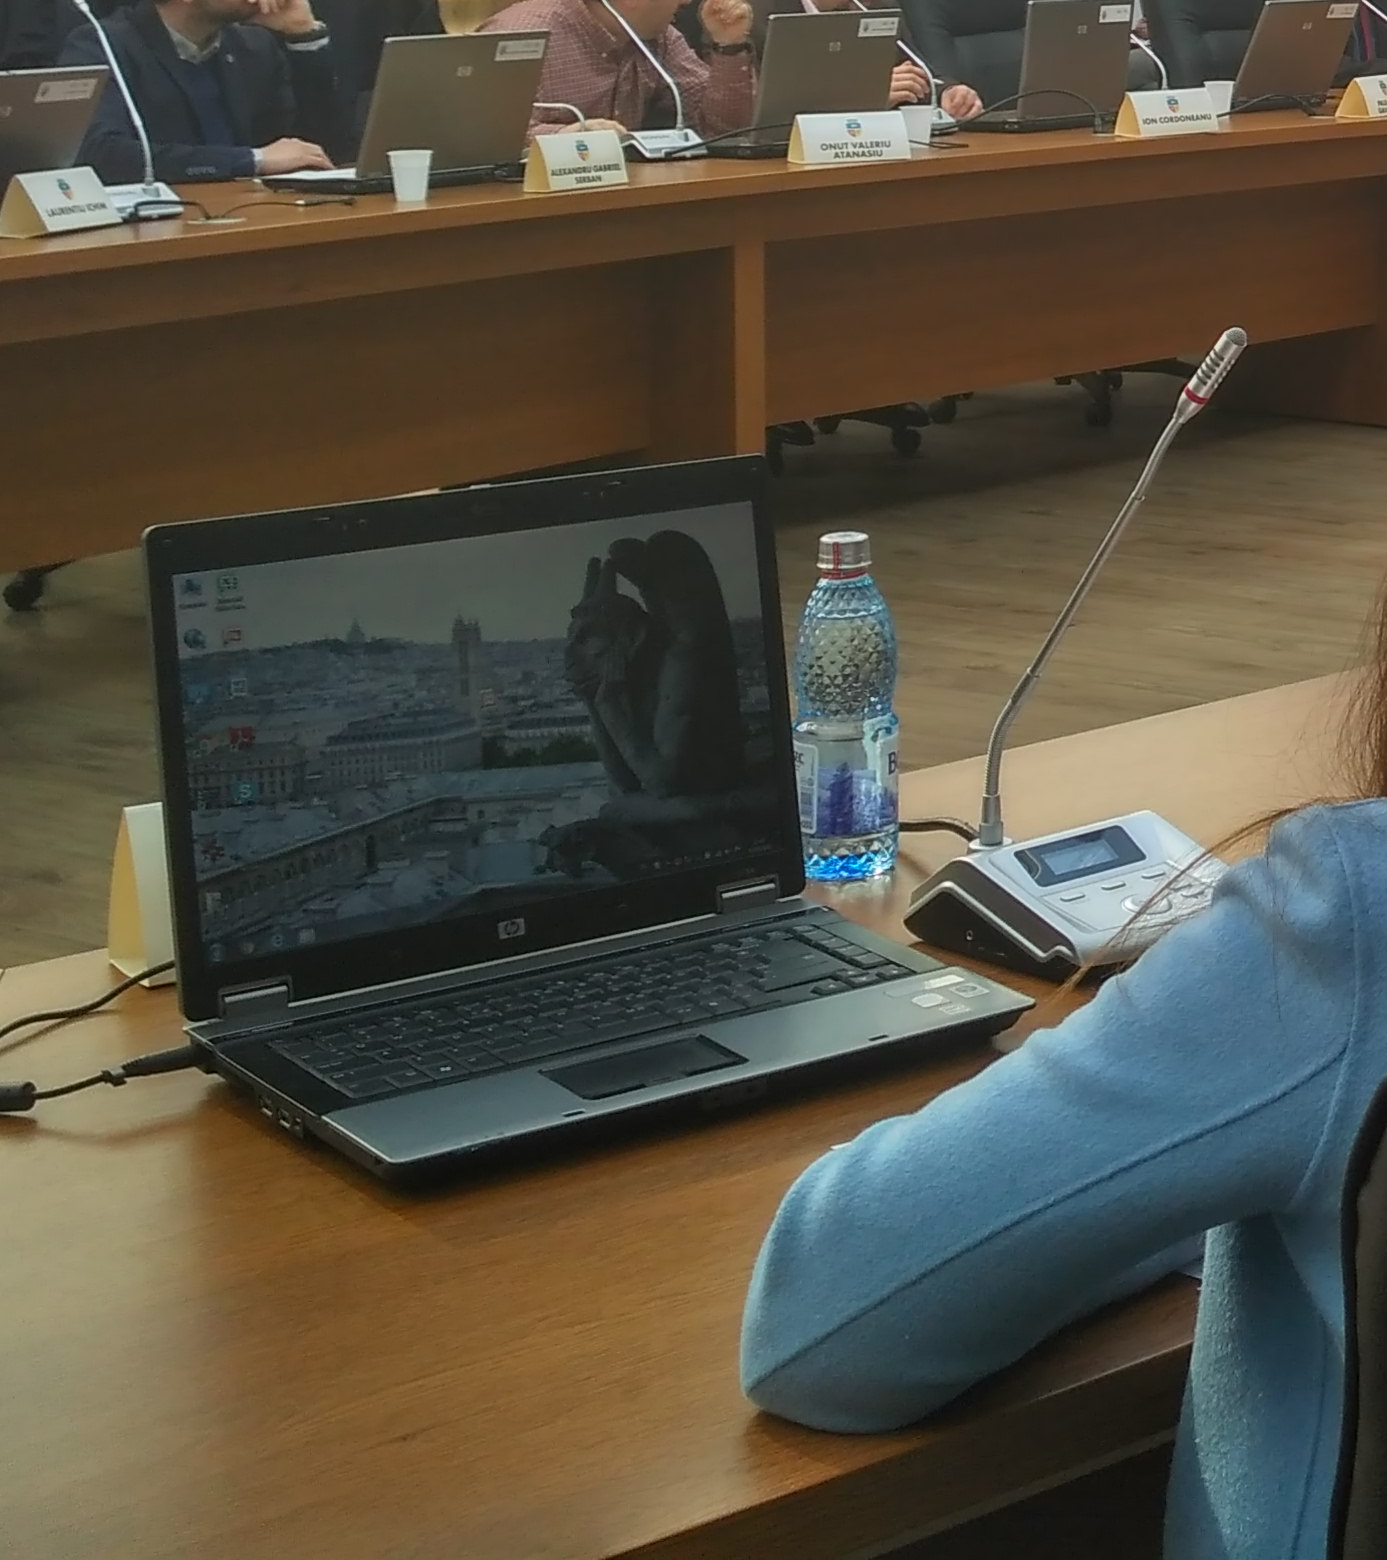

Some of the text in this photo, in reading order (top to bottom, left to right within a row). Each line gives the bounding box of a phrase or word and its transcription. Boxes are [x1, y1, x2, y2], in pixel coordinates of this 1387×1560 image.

[1142, 113, 1212, 126] ION CORDONEANU
[820, 140, 891, 152] ONUT VALERIU
[833, 149, 884, 159] ATANASIU
[550, 166, 592, 177] ALEXANDRU
